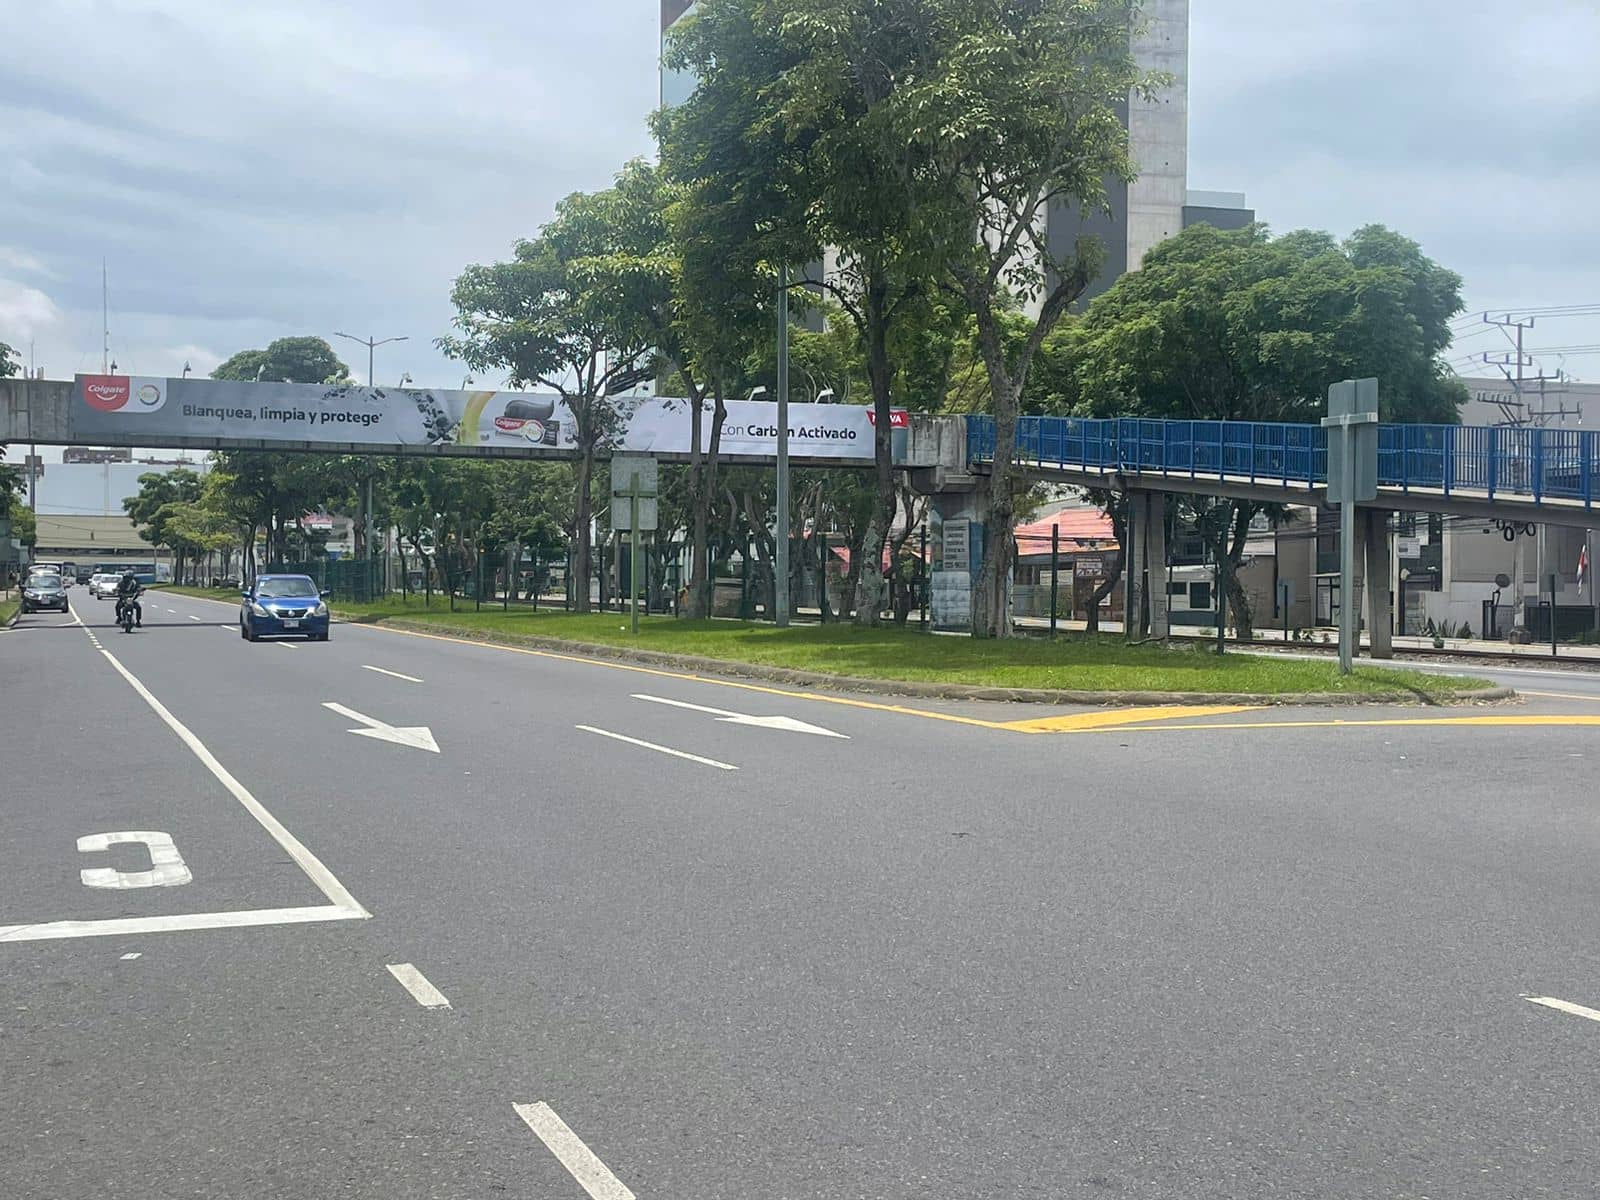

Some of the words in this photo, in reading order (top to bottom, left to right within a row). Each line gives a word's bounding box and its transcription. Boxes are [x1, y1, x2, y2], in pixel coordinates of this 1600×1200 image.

[87, 384, 126, 394] Colgate
[182, 404, 257, 421] Blanquea,
[260, 406, 306, 423] limpia
[308, 411, 317, 424] y
[747, 424, 795, 438] Carbn
[798, 426, 857, 440] Activado
